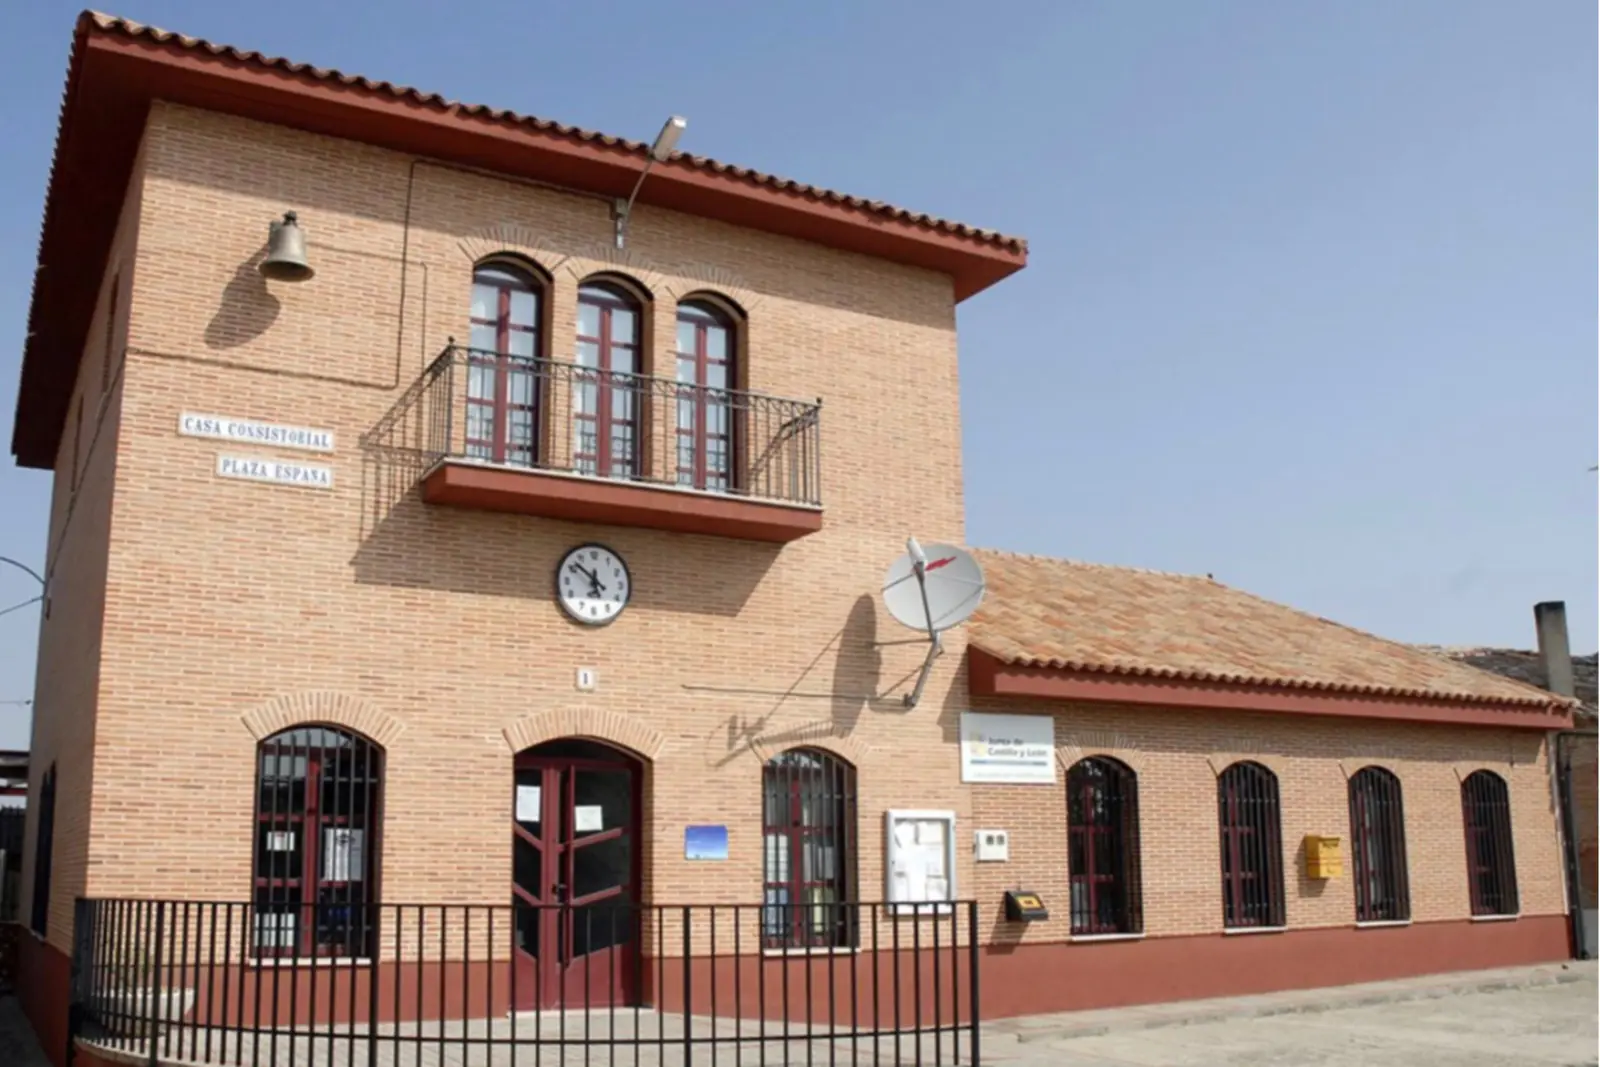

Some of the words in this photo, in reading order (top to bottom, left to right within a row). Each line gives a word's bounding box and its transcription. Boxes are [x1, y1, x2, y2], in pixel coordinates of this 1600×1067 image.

[184, 417, 221, 435] CASA
[227, 422, 329, 448] CONSISTORIAL
[222, 458, 268, 477] PLAZA
[988, 736, 1011, 745] Junta
[987, 747, 1018, 756] Castilla
[1026, 748, 1047, 756] León
